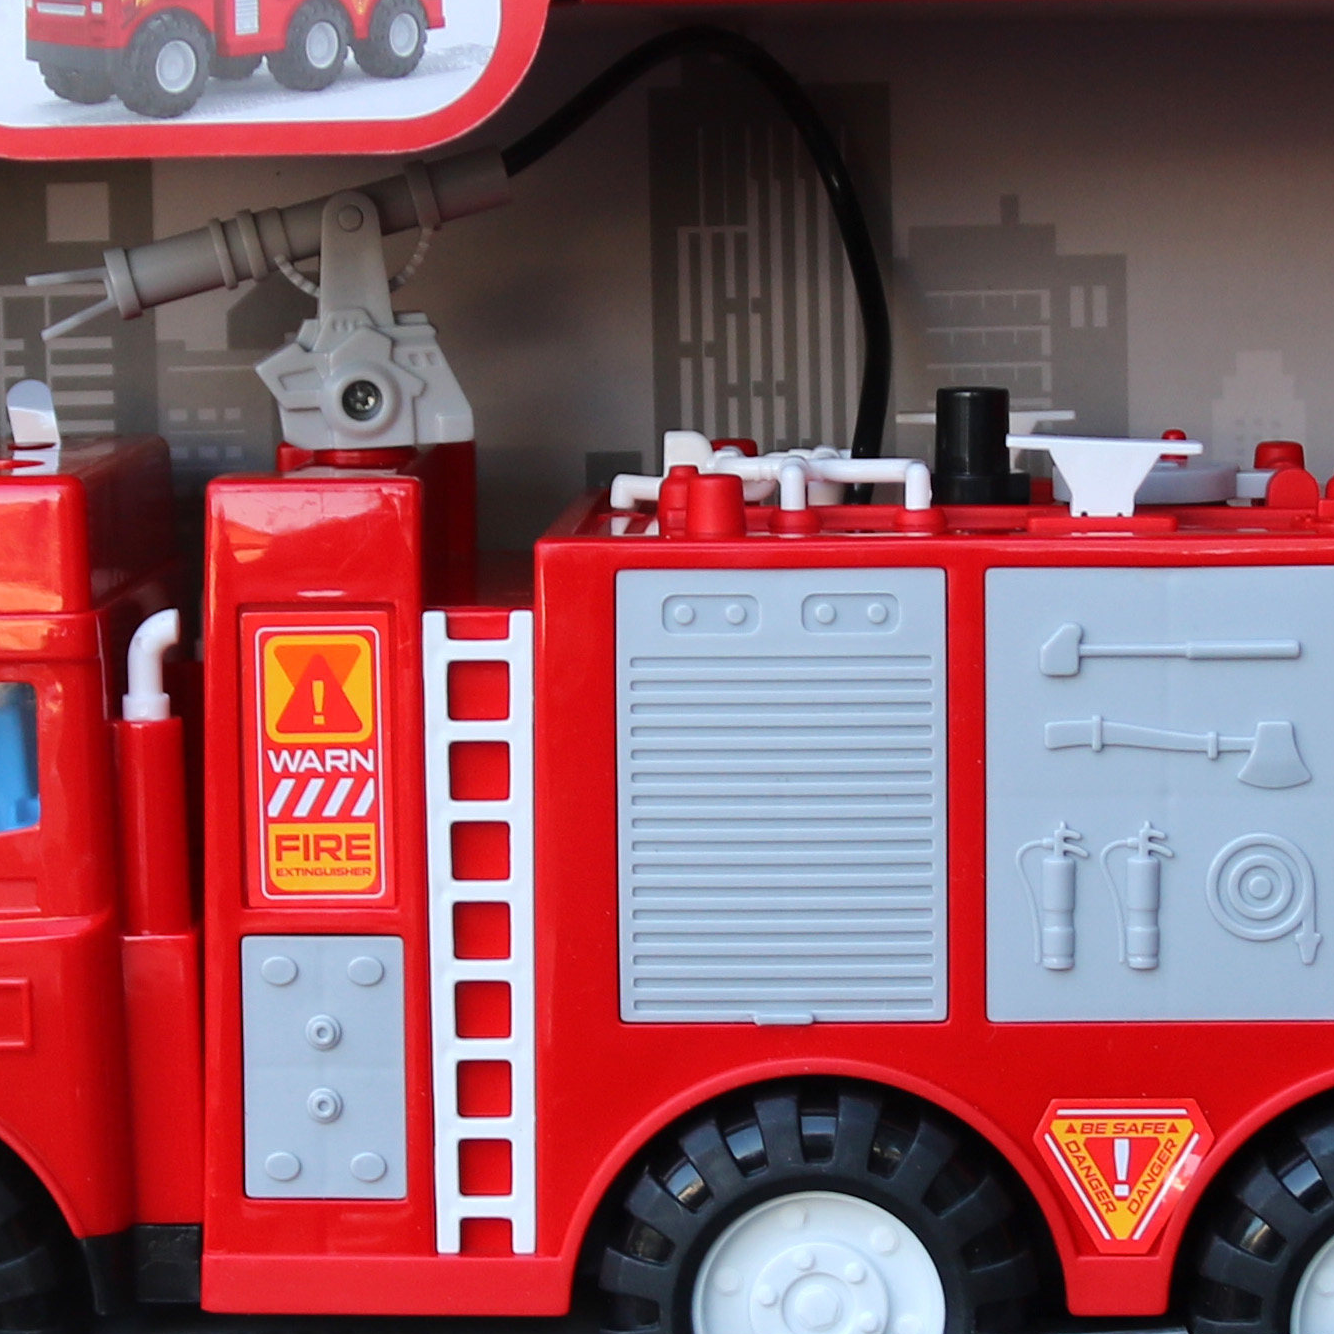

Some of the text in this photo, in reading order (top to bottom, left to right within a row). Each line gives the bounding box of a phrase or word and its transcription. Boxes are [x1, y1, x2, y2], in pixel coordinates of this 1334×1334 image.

[267, 749, 374, 773] WARN
[275, 834, 371, 861] FIRE
[276, 868, 371, 877] EXTINGUISHER
[1080, 1122, 1166, 1134] BE SAFE
[1065, 1139, 1117, 1214] DANGER
[1127, 1138, 1178, 1215] DANGER
